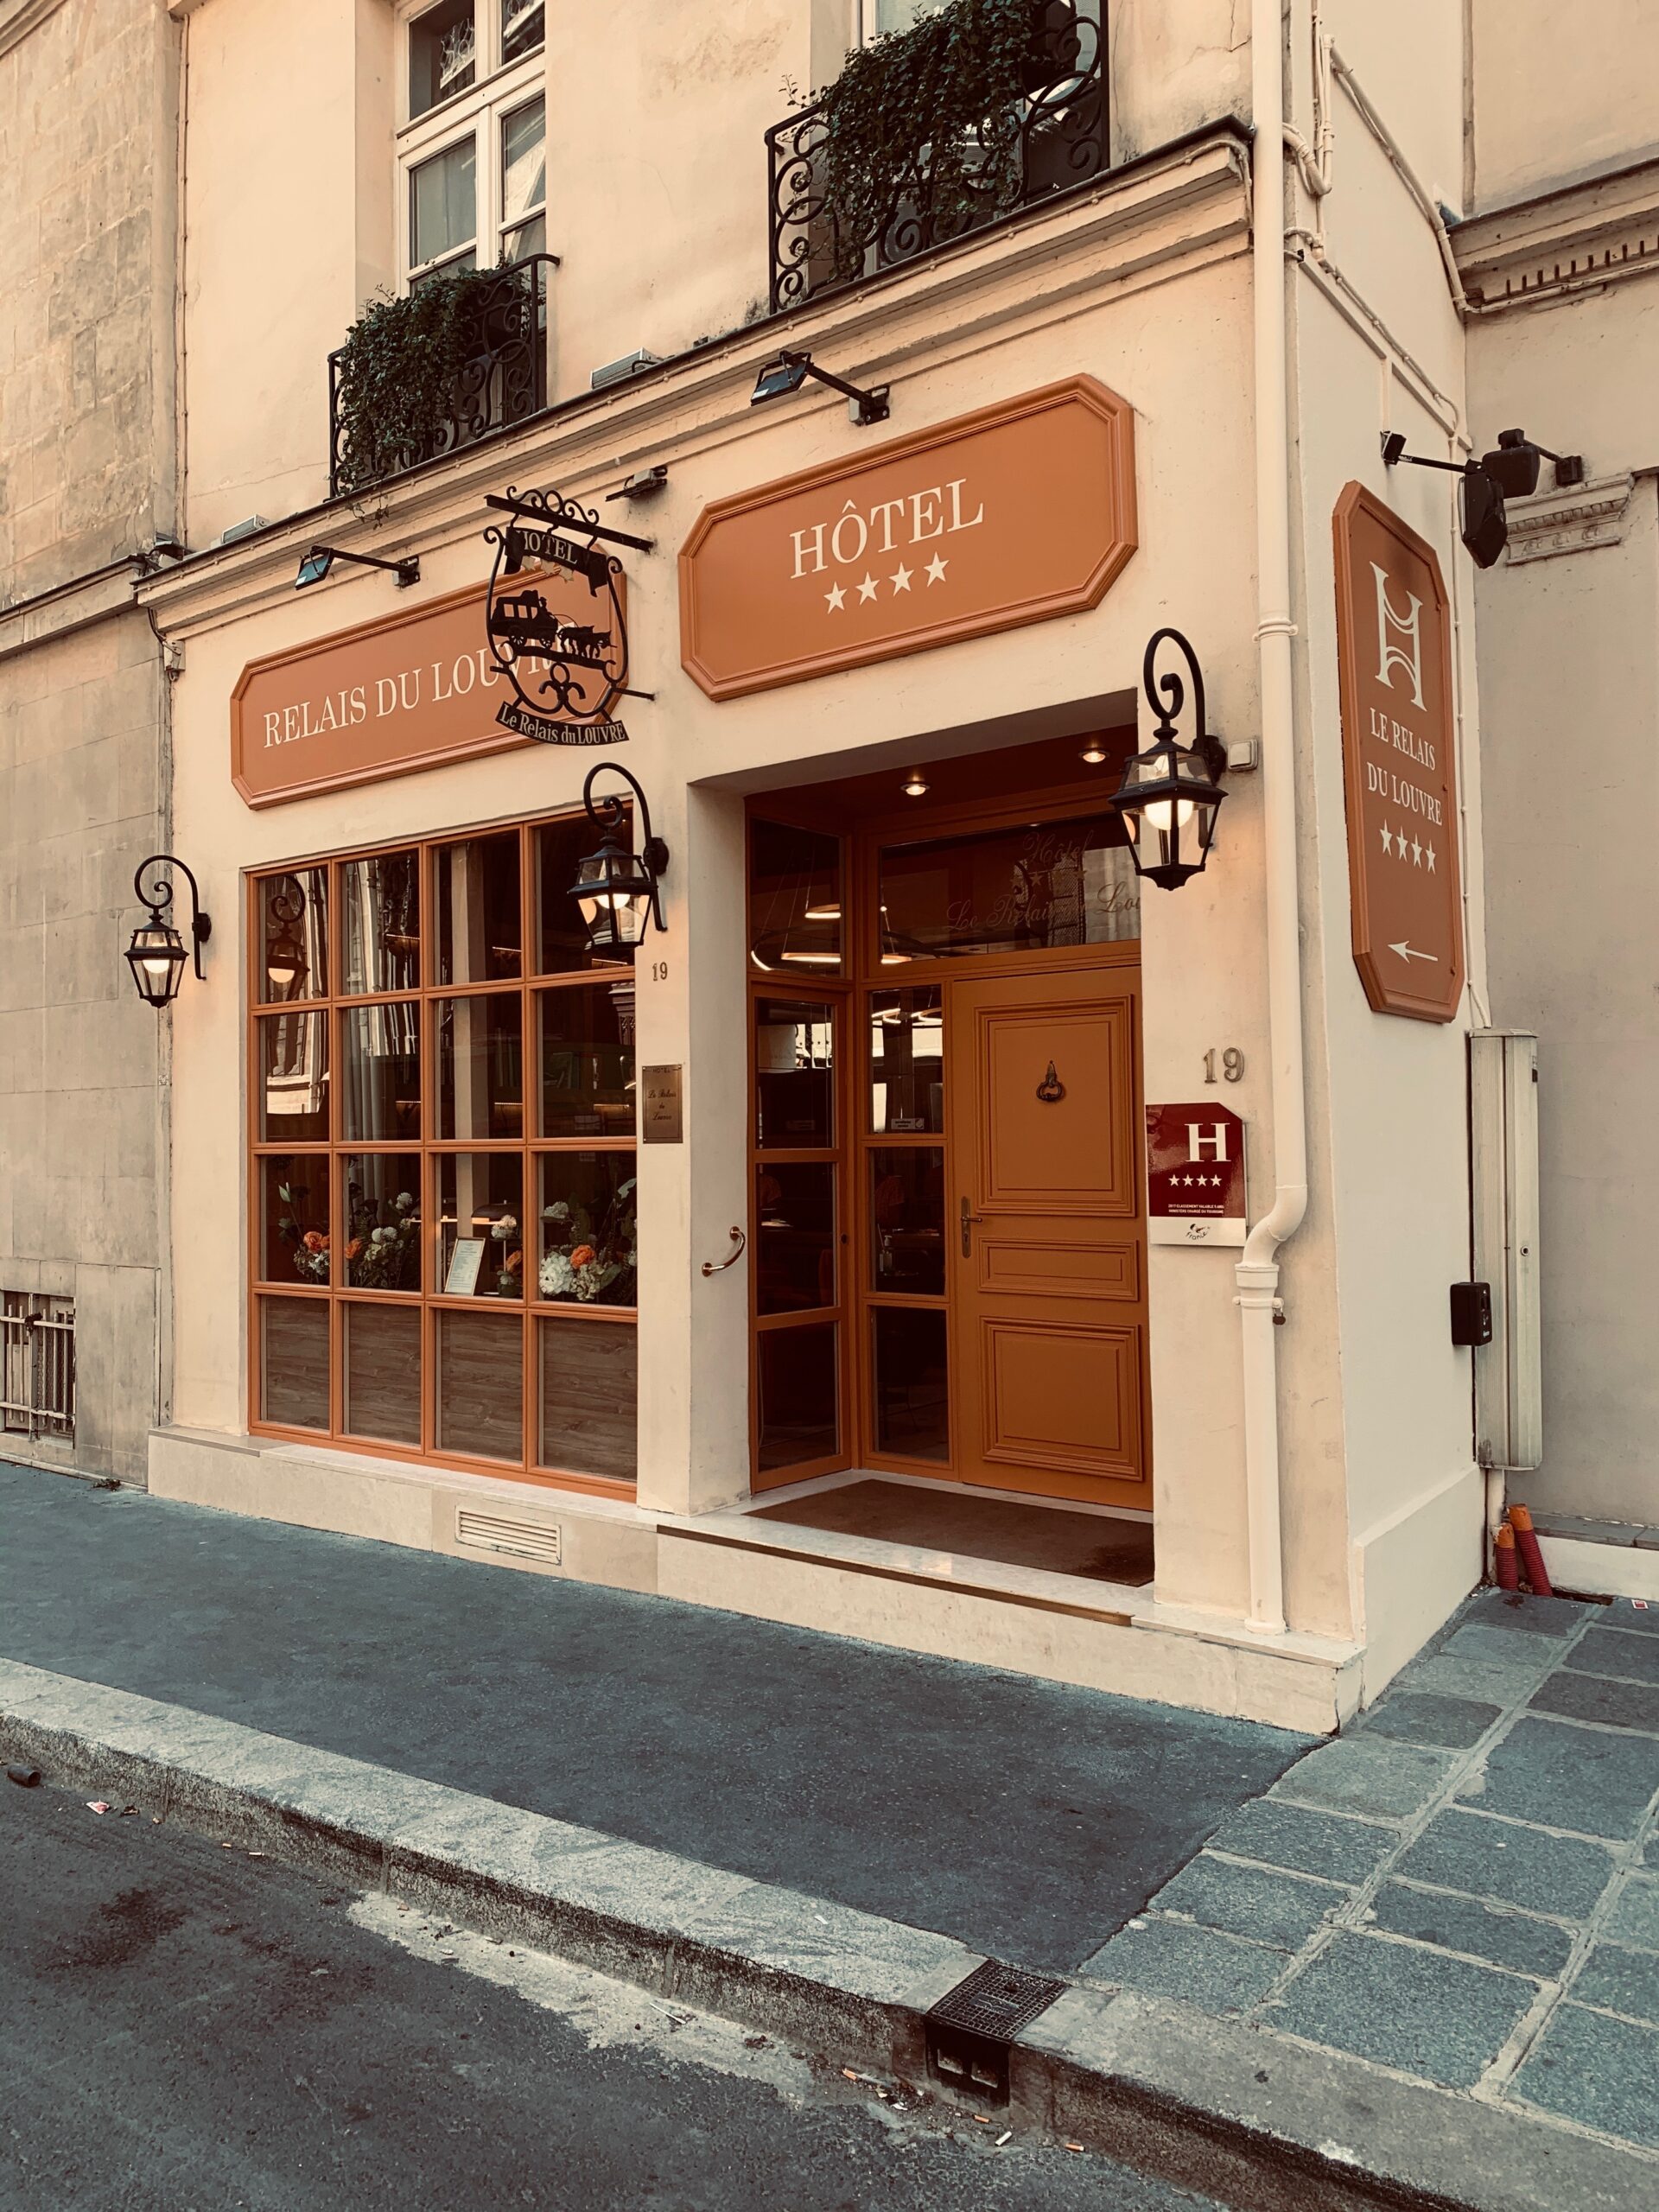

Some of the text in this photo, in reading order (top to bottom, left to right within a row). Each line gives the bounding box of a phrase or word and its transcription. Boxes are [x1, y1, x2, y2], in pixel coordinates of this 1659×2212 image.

[790, 479, 983, 579] HÔTEL
[264, 685, 366, 748] RELAIS
[375, 669, 422, 717] DU
[499, 704, 626, 745] Le Relais du LOUVRE
[1370, 707, 1435, 771] LE RELAIS
[1367, 761, 1442, 826] DU LOUVRE
[652, 962, 668, 981] 19
[1203, 1046, 1244, 1084] 19
[1184, 1122, 1231, 1162] H
